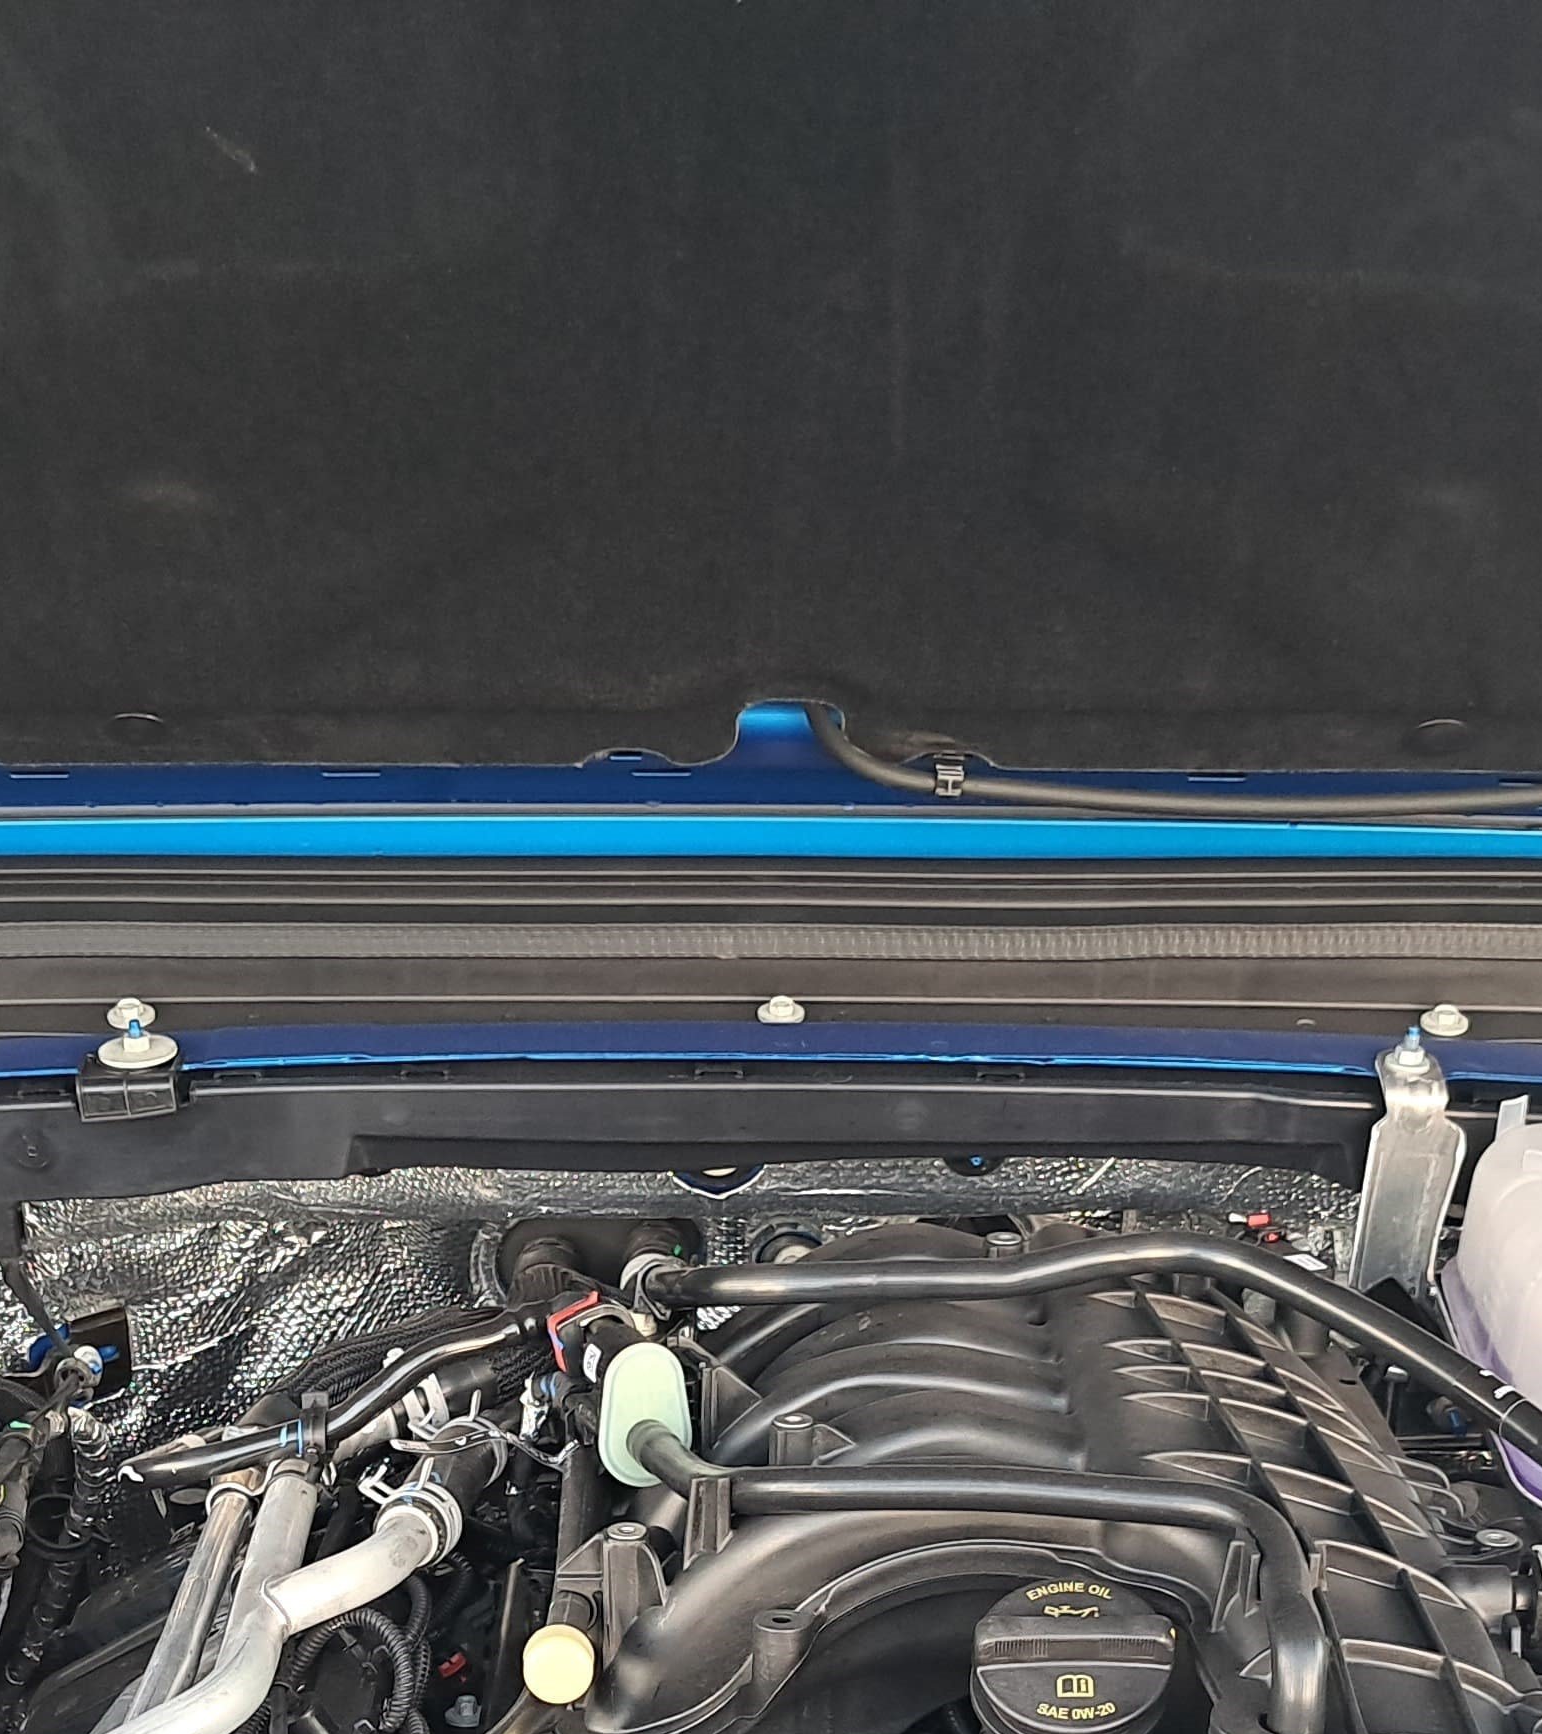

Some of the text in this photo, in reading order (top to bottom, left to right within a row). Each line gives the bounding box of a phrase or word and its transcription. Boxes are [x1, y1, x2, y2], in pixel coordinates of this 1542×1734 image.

[1026, 1581, 1114, 1601] ENGINE OIL
[1036, 1702, 1116, 1720] SAE 0W-20
